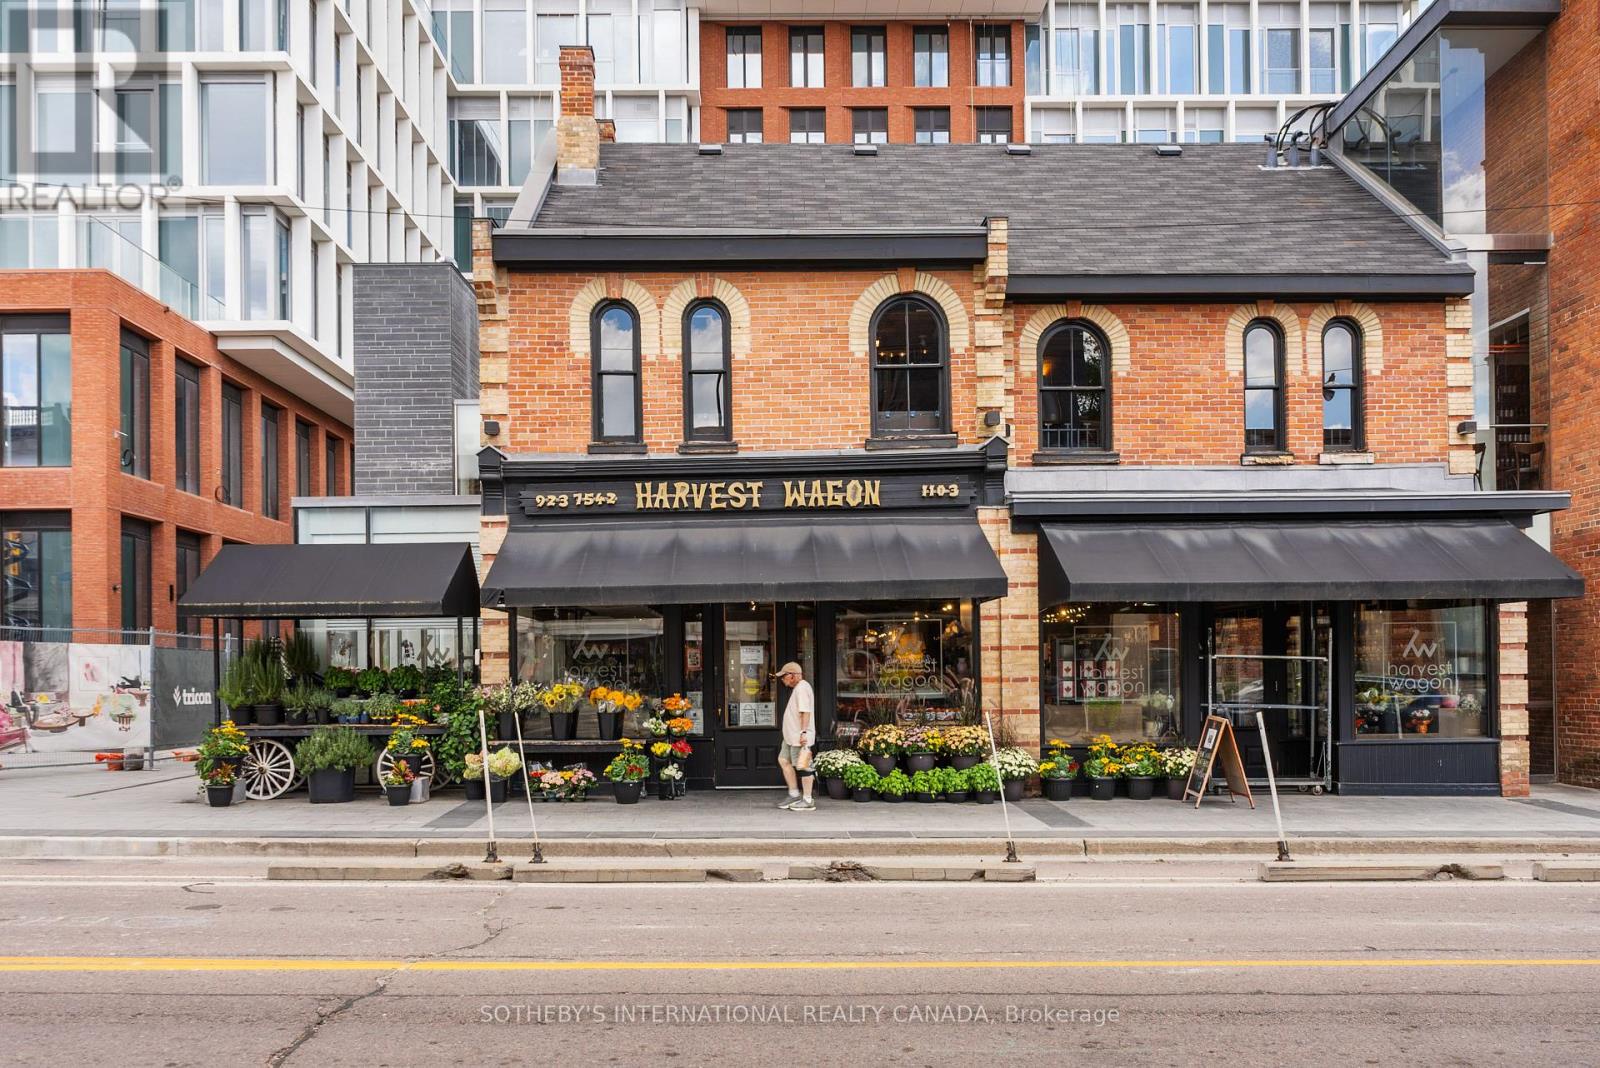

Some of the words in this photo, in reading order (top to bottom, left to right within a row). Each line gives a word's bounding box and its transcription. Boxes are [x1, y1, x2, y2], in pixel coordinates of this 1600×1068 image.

[535, 494, 569, 508] 923
[573, 492, 618, 506] 7542
[635, 480, 763, 510] HARVEST
[783, 479, 880, 508] WAGON
[921, 483, 960, 498] 1103
[872, 658, 937, 674] harvest
[1079, 664, 1145, 680] harest
[1387, 660, 1453, 676] harvest
[873, 674, 938, 691] wagon
[1388, 677, 1453, 693] wagon
[182, 687, 212, 705] tricon
